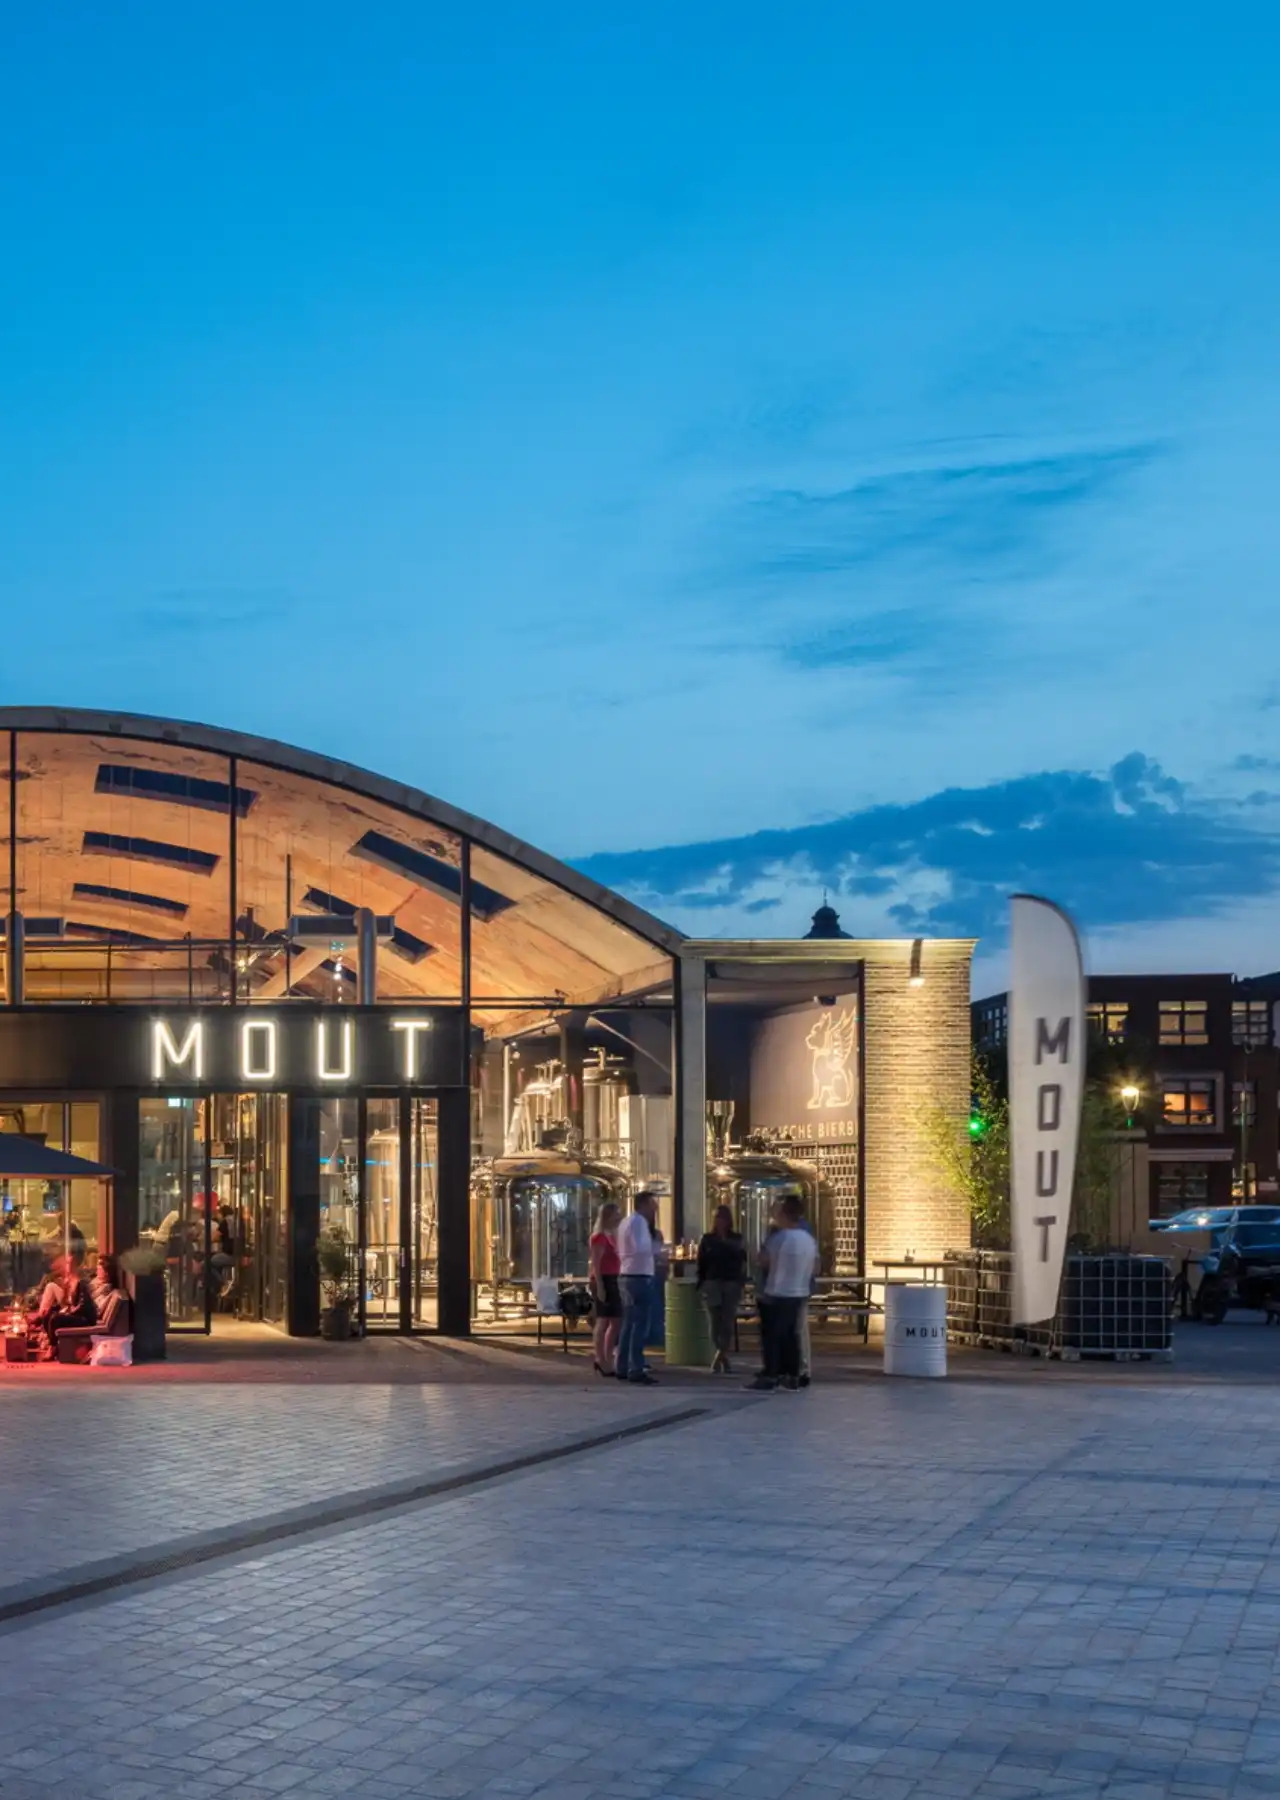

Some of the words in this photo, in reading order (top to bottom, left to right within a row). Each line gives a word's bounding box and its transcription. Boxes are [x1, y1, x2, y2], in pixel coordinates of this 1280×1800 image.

[151, 1019, 431, 1080] MOUT
[817, 1120, 858, 1138] BIERB
[1033, 1016, 1072, 1263] MOUT
